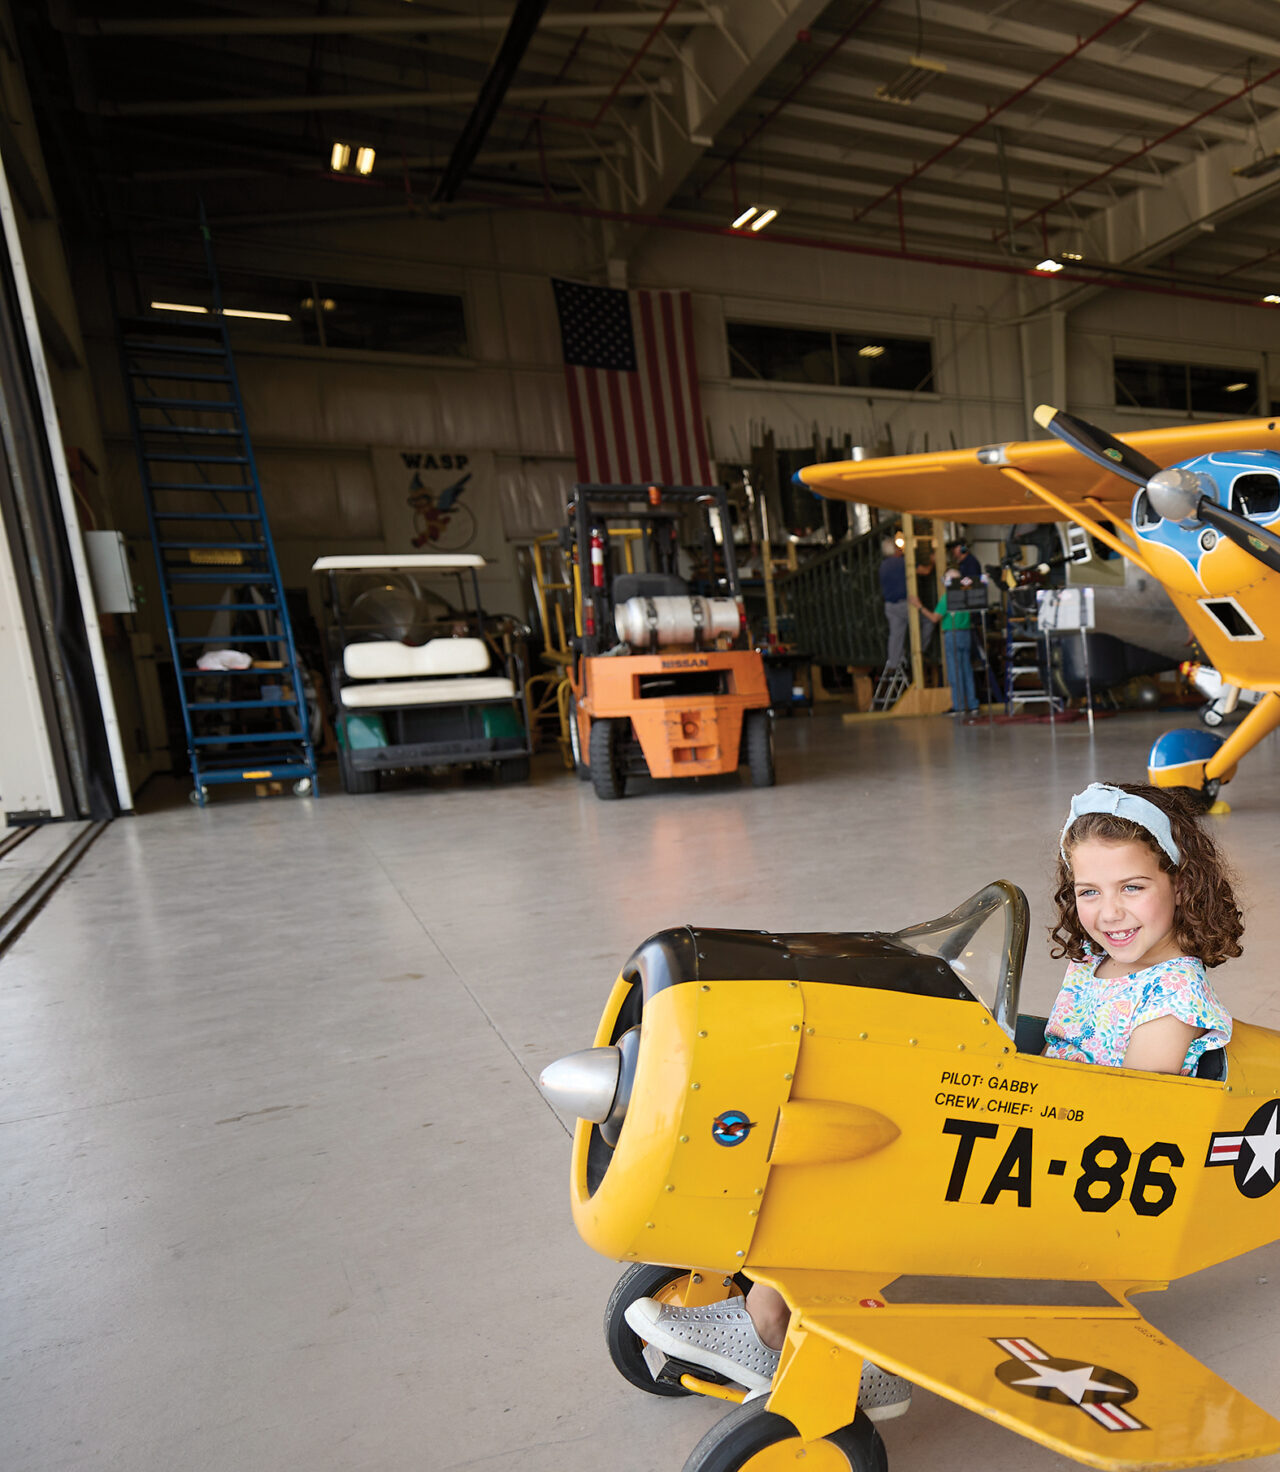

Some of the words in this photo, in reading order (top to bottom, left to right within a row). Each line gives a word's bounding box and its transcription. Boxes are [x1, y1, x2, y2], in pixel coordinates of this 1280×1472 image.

[401, 453, 468, 469] WASP
[662, 659, 708, 668] NISSAN
[941, 1071, 984, 1087] PILOT:
[988, 1077, 1038, 1095] GABBY
[935, 1093, 980, 1109] CREW
[987, 1099, 1033, 1115] CHIEF:
[1040, 1106, 1085, 1122] JAOB
